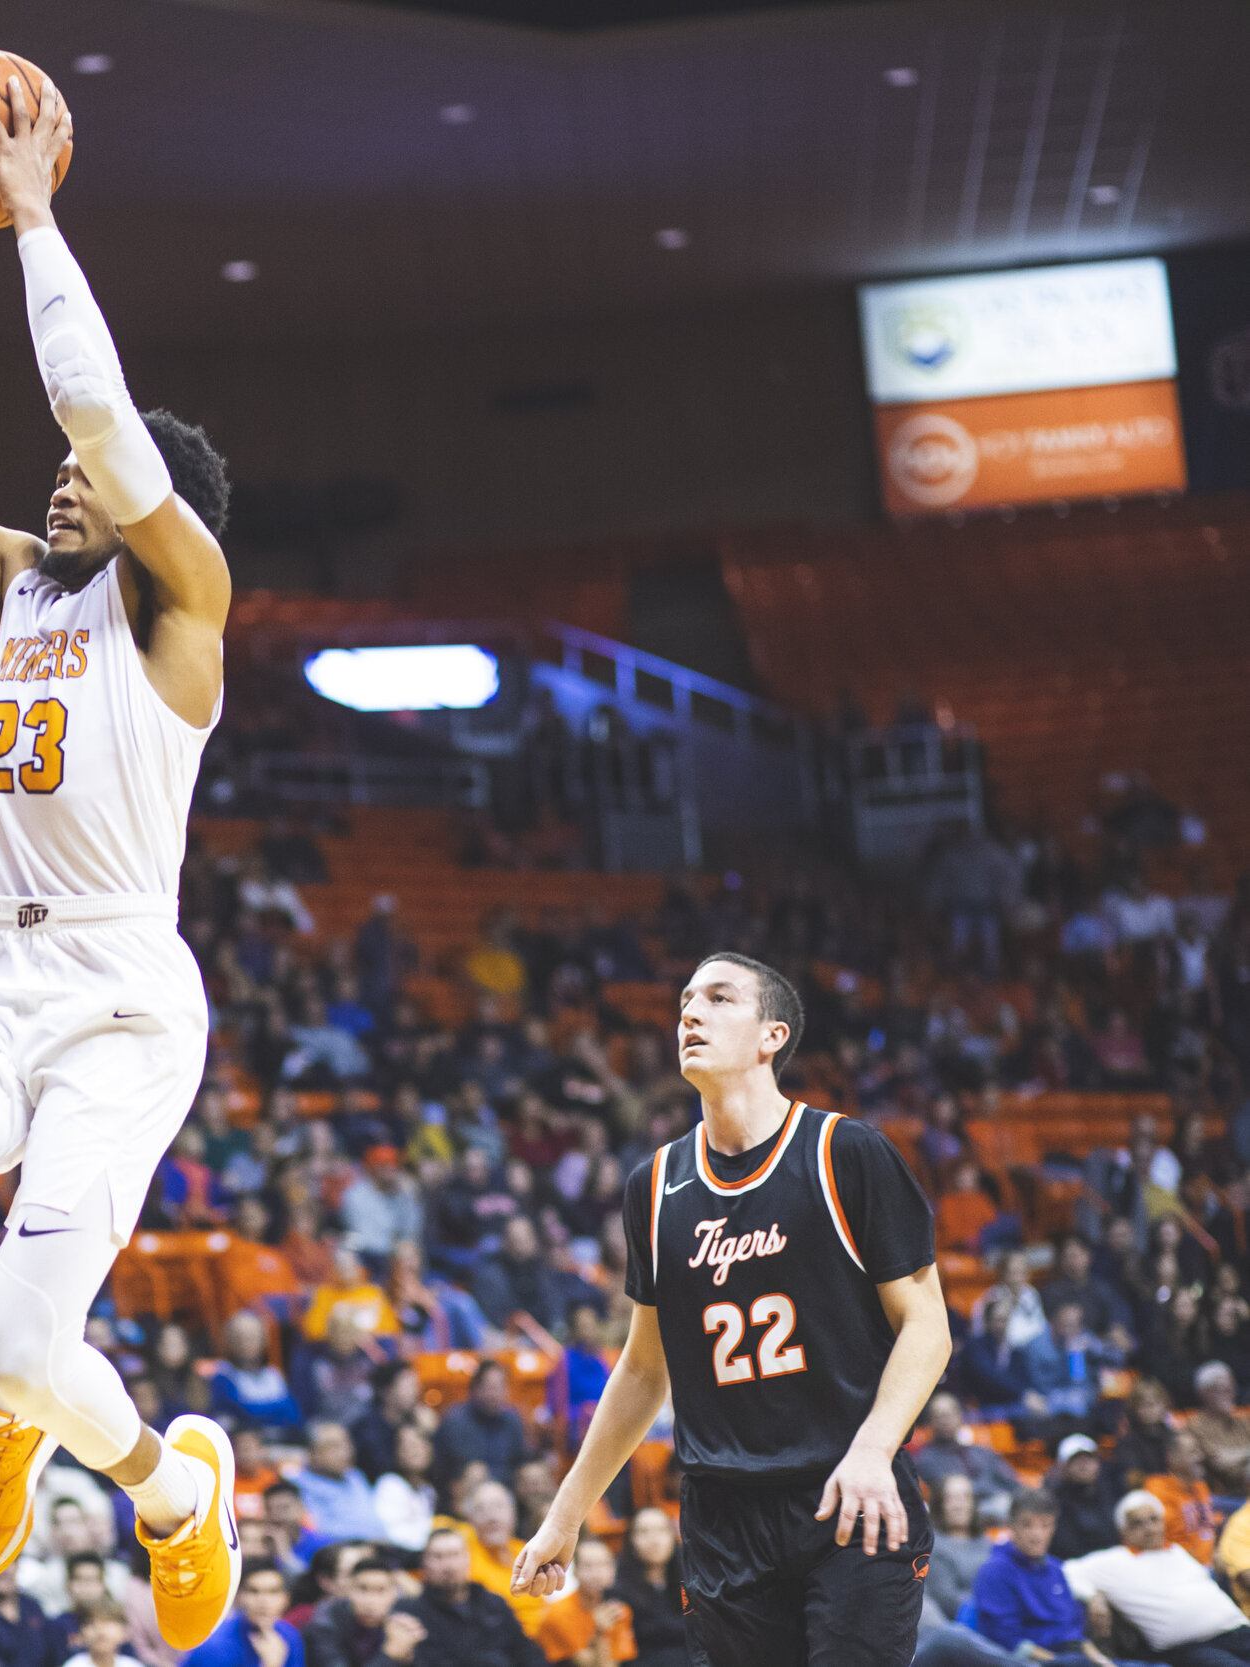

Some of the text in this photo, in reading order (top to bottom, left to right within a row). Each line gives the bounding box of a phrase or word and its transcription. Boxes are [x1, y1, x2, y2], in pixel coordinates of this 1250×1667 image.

[18, 902, 49, 928] UTEP
[688, 1217, 787, 1286] Tigers
[702, 1292, 808, 1387] 22
